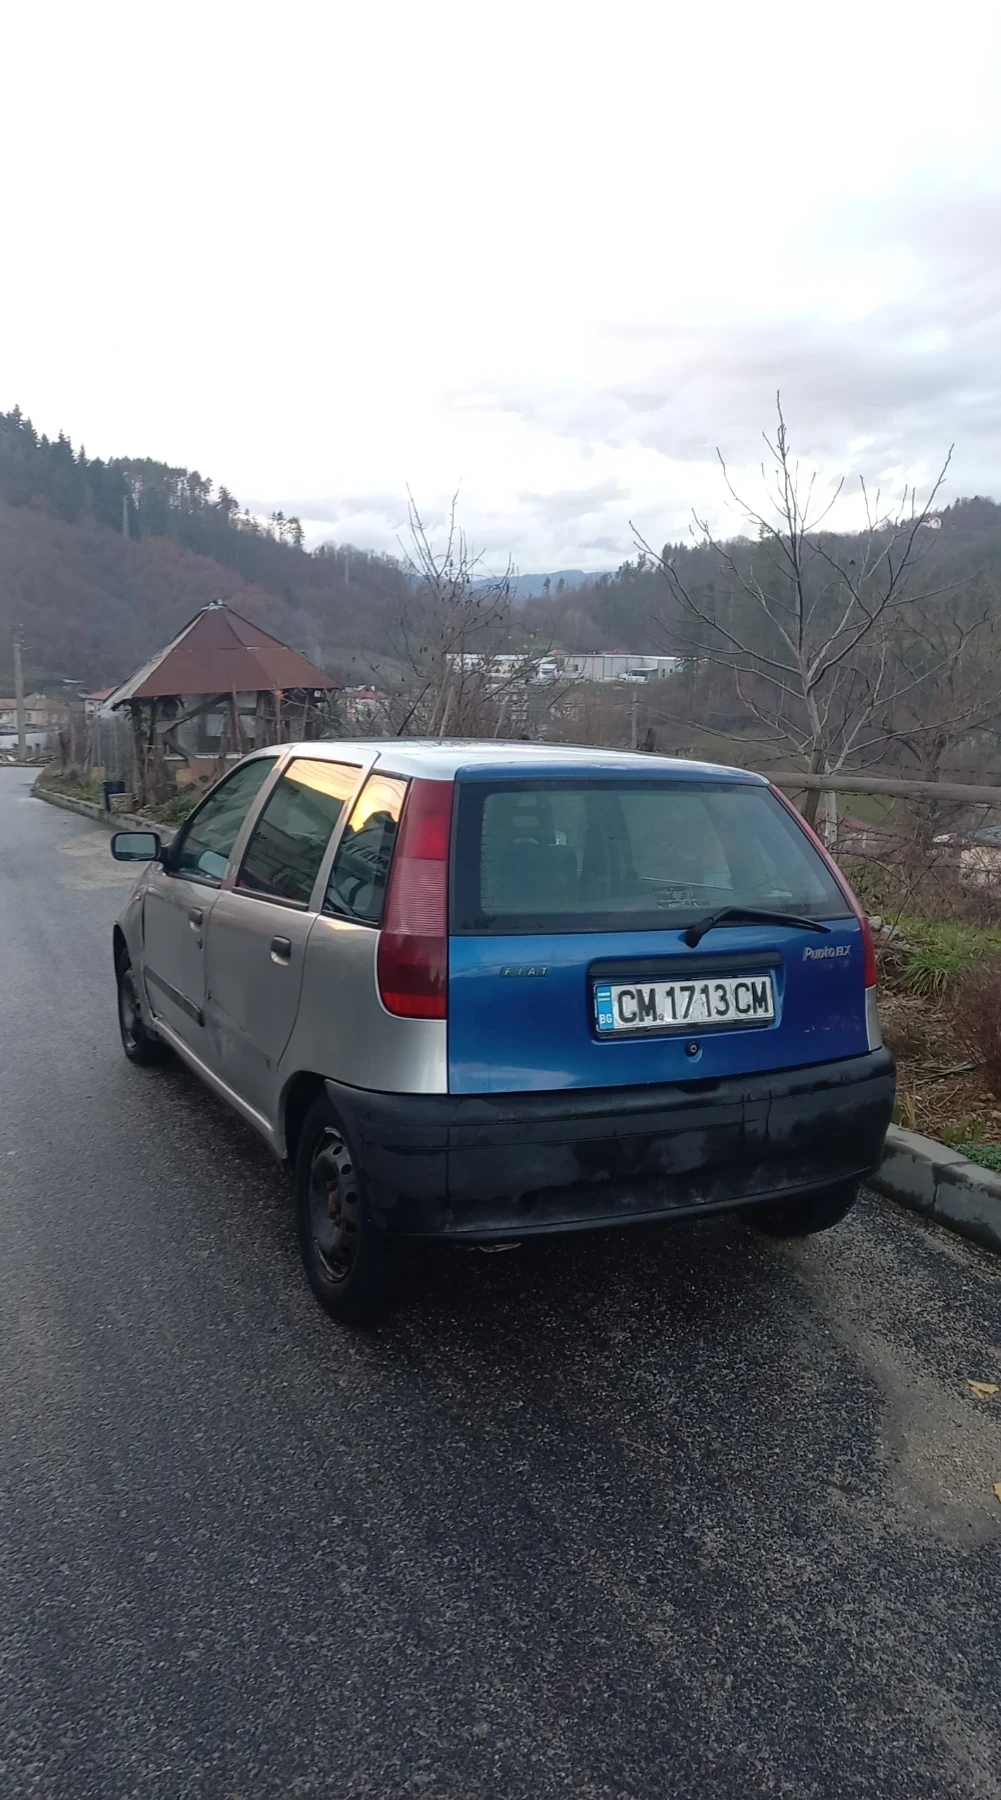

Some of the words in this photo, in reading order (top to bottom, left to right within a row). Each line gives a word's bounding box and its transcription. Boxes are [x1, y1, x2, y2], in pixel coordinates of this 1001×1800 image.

[802, 946, 835, 961] Punto
[504, 967, 548, 976] FIAT
[599, 1013, 613, 1024] BG
